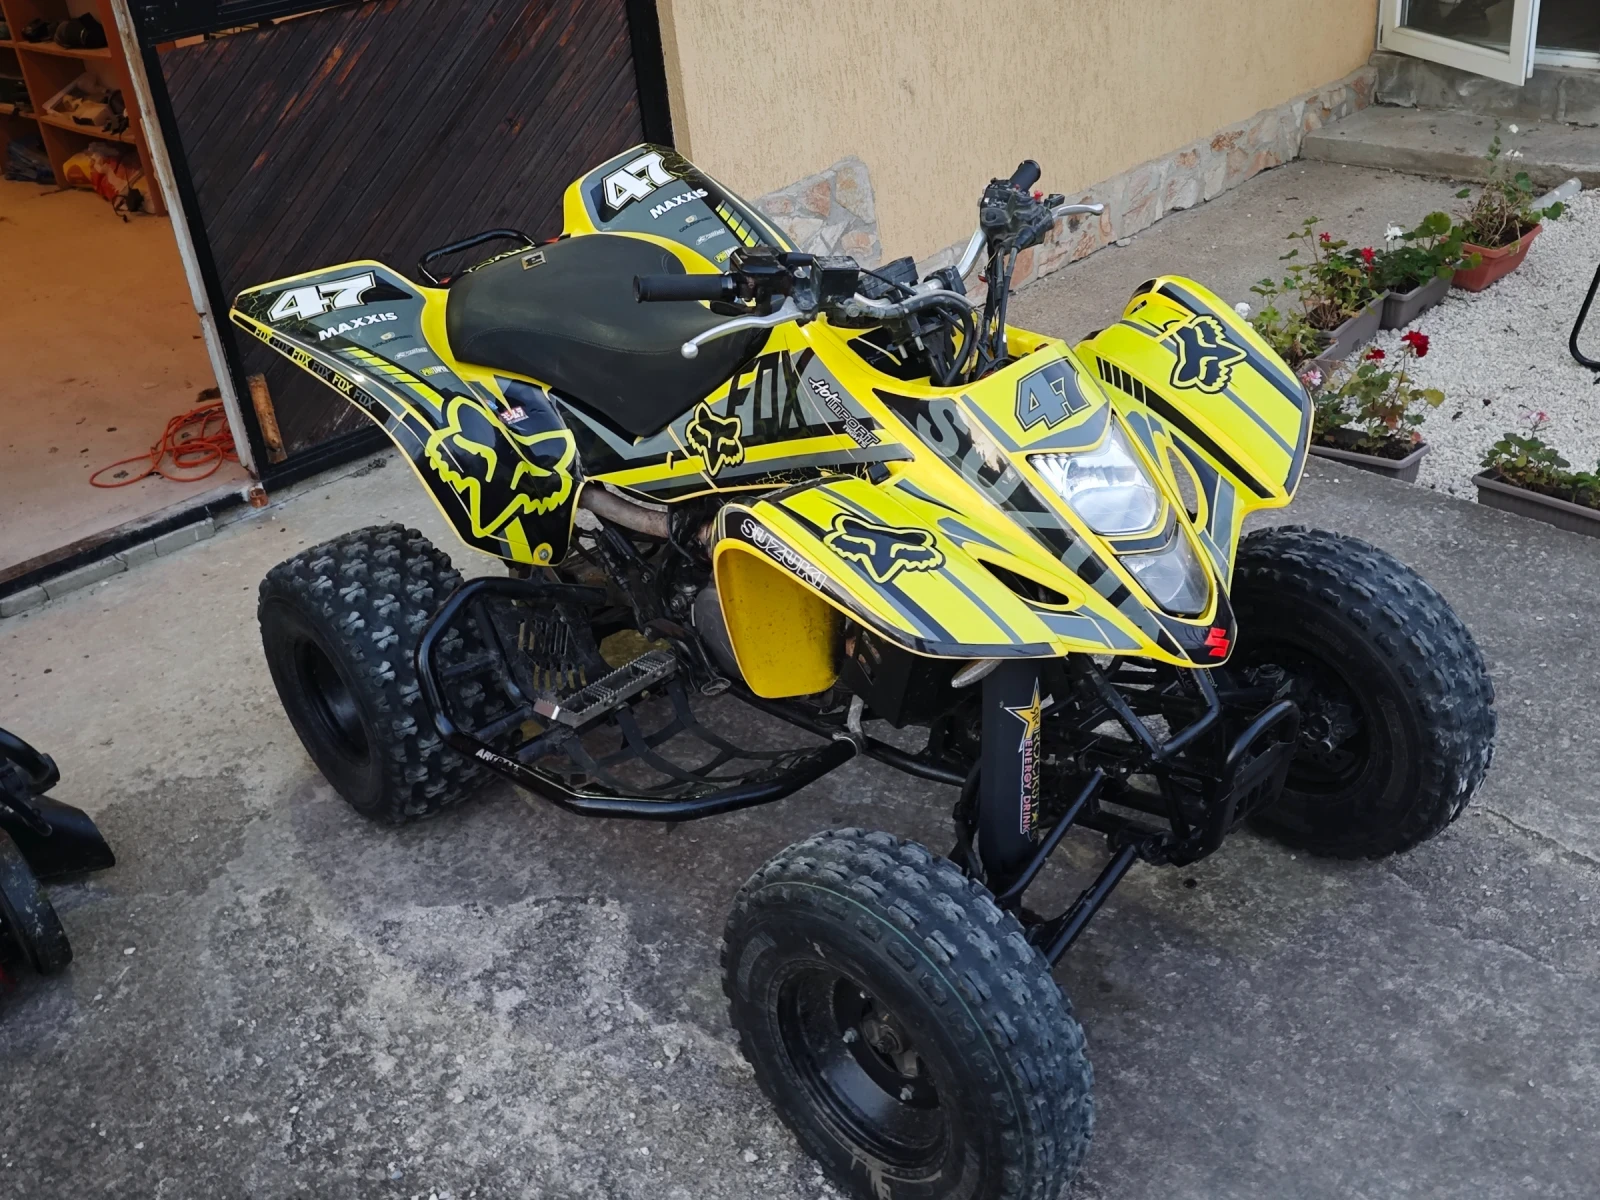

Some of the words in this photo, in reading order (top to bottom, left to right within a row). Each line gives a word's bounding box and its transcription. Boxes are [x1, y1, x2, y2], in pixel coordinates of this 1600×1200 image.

[603, 151, 677, 210] 47
[649, 188, 709, 219] MAXXIS
[267, 270, 376, 323] 47
[318, 312, 398, 341] MAXXIS
[254, 327, 272, 346] FOX
[272, 337, 292, 355] FOX
[291, 348, 312, 368] FOX
[312, 361, 332, 380] FOX
[332, 373, 354, 393] FOX
[353, 390, 377, 410] FOX
[726, 346, 815, 440] FOX
[1014, 356, 1090, 432] 47
[740, 518, 828, 590] SUZUKI
[1024, 739, 1034, 790] ENERGY
[1022, 795, 1033, 832] DRINK
